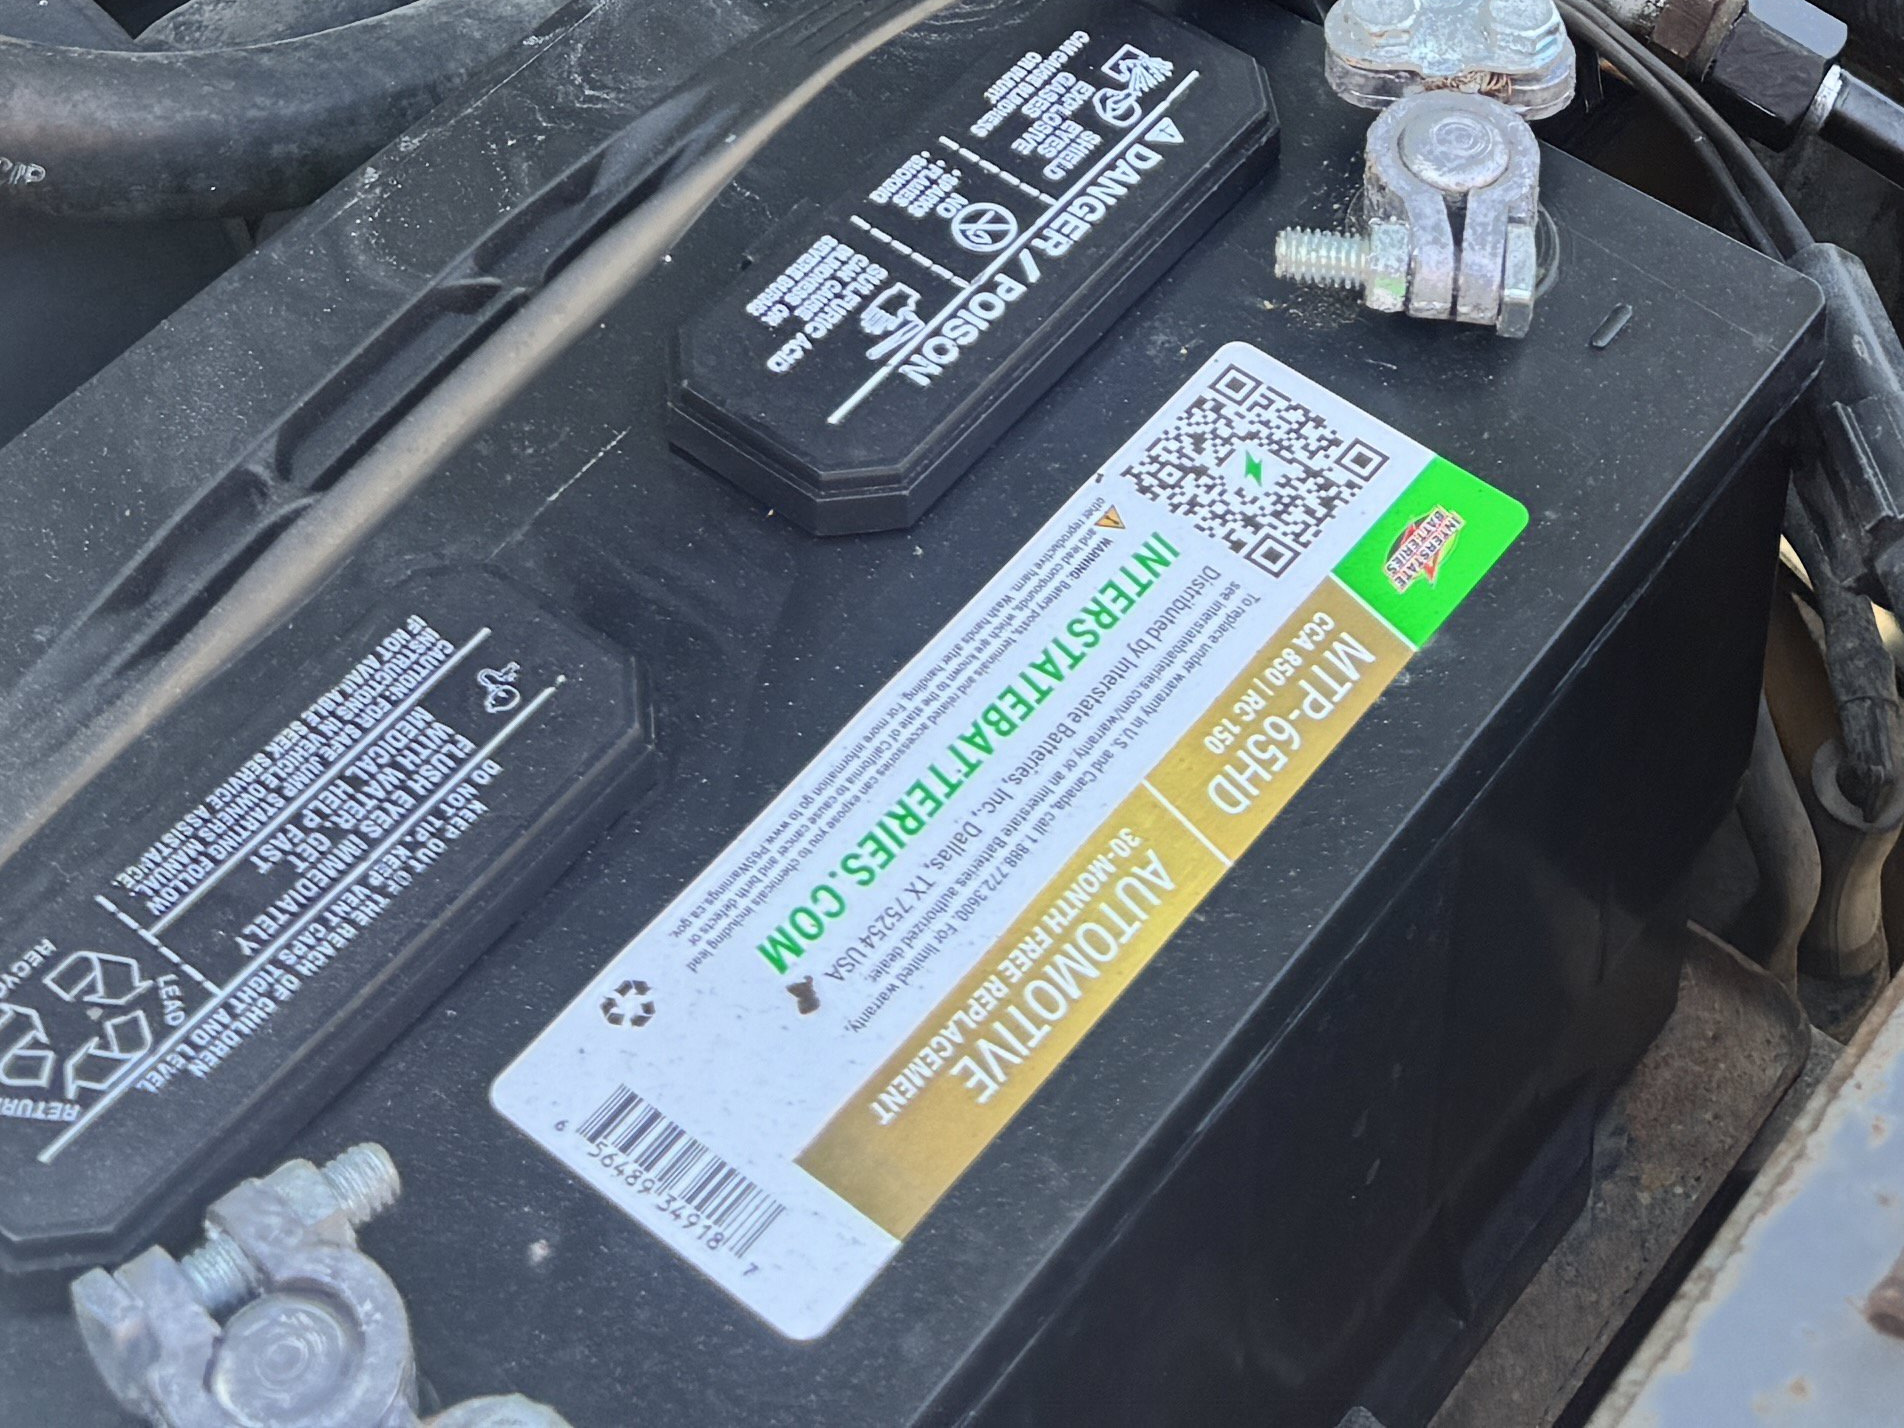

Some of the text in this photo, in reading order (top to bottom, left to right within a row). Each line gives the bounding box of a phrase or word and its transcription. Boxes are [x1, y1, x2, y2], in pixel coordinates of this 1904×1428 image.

[1021, 71, 1076, 118] GASES
[1010, 79, 1096, 155] EXPLOSIVE
[1036, 119, 1083, 158] EYES
[1042, 129, 1102, 180] SHIELD
[935, 192, 968, 218] NO
[897, 132, 1163, 386] DANGER / POISON
[793, 253, 869, 320] CAN CAUSE
[766, 263, 888, 372] SULFURIC ACID
[1080, 496, 1106, 520] other
[1032, 517, 1086, 570] reproductive
[1059, 543, 1084, 566] lead
[1077, 526, 1097, 547] and
[1380, 509, 1449, 578] BATTERIES
[1393, 515, 1461, 590] INTERSTATE
[985, 593, 1016, 618] Wash
[1035, 579, 1072, 611] Battery
[1144, 564, 1222, 642] Distributed
[1218, 580, 1241, 601] see
[1240, 592, 1261, 607] To
[405, 613, 427, 634] IF
[960, 616, 992, 644] hands
[987, 612, 1017, 639] which
[1206, 605, 1246, 644] replace
[375, 627, 412, 661] NOT
[940, 642, 964, 665] after
[972, 635, 1017, 676] terminals
[973, 637, 991, 654] are
[1125, 637, 1156, 659] by
[1181, 642, 1213, 674] under
[335, 626, 440, 720] INSTRUCTIONS
[935, 680, 951, 692] to
[945, 652, 980, 682] known
[955, 675, 977, 696] and
[1071, 599, 1227, 759] interstatebatteries.com/warranty
[1203, 611, 1335, 754] CCA 850 RC 150
[300, 653, 381, 727] AVAILABLE
[920, 690, 941, 707] the
[926, 692, 960, 725] related
[1066, 655, 1139, 724] Interstate
[1139, 672, 1186, 717] warranty
[316, 713, 343, 737] IN
[348, 693, 392, 728] FOR
[885, 701, 907, 719] For
[897, 705, 924, 730] state
[1129, 715, 1148, 728] in
[1206, 631, 1376, 815] MTP-65HD
[264, 720, 309, 758] SEEK
[312, 723, 362, 762] SAFE
[394, 721, 455, 771] WITH
[861, 717, 890, 743] more
[875, 721, 930, 776] accessories
[887, 727, 901, 743] of
[259, 732, 326, 788] VEHICLE
[470, 758, 503, 785] DO
[756, 531, 1180, 975] INTERSTATEBATTERIES.COM
[811, 741, 867, 796] information
[844, 739, 892, 785] California
[1061, 757, 1078, 772] or
[1089, 748, 1114, 774] and
[204, 752, 272, 810] SERVICE
[249, 705, 436, 874] MEDICAL HELP FAST
[272, 751, 324, 797] JUMP
[834, 783, 850, 796] to
[857, 775, 879, 795] can
[1046, 769, 1066, 786] an
[197, 782, 267, 842] OWNERS
[438, 782, 479, 817] NOT
[787, 808, 804, 821] to
[797, 793, 815, 810] go
[806, 794, 838, 825] cause
[825, 793, 861, 829] expose
[999, 784, 1056, 837] Interstate
[202, 792, 286, 860] STARTING
[776, 823, 810, 857] cancer
[807, 826, 830, 848] you
[1031, 810, 1056, 836] call
[234, 733, 476, 956] FLUSH EYES IMMEDIATELY
[286, 831, 332, 873] GET
[797, 846, 813, 859] to
[953, 835, 1008, 887] Batteries
[367, 844, 412, 886] KEEP
[750, 857, 800, 906] chemicals
[756, 855, 779, 878] and
[145, 855, 215, 915] FOLLOW
[733, 874, 764, 899] birth
[902, 874, 936, 901] TX
[322, 884, 371, 926] VENT
[698, 897, 738, 934] defects
[857, 896, 914, 949] 75254
[899, 885, 959, 949] authorized
[187, 799, 489, 1076] KEEP OUT OF THE REACH OF CHILDREN
[277, 922, 328, 965] CAPS
[687, 932, 702, 946] or
[705, 904, 756, 950] including
[932, 921, 959, 944] For
[685, 948, 714, 973] lead
[822, 946, 867, 981] USA
[870, 827, 1142, 1125] 30-MONTH FREE REPLACEMENT
[894, 942, 941, 986] limited
[948, 848, 1176, 1104] AUTOMOTIVE
[156, 973, 186, 1028] LEAD
[227, 963, 285, 1014] TIGHT
[190, 1007, 232, 1046] AND
[135, 1042, 196, 1092] LEVEL
[553, 1119, 759, 1276] 6 56489 34918 7
